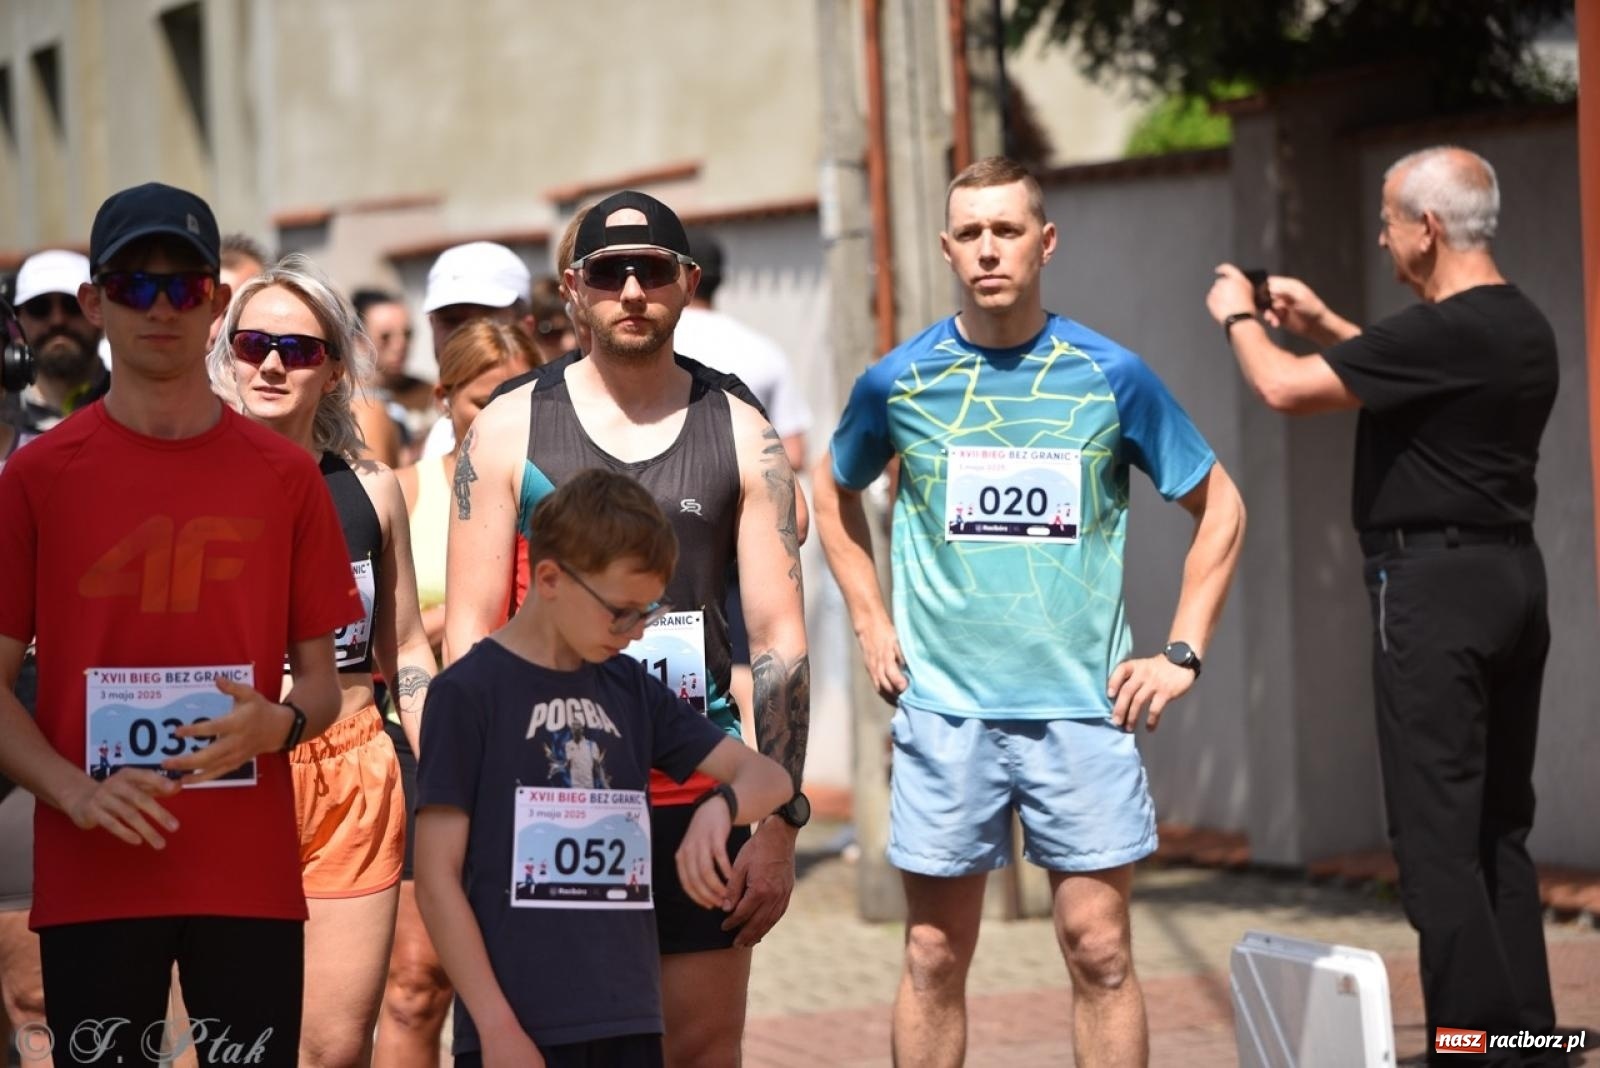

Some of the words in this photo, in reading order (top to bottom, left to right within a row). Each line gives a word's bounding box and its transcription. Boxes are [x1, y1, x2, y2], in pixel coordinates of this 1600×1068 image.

[981, 451, 1005, 459] BIEG
[1009, 451, 1028, 460] BEZ
[1031, 452, 1071, 461] GRANIC
[979, 486, 1048, 517] 020
[78, 514, 266, 613] 4F
[101, 672, 126, 684] XVII
[130, 671, 161, 684] BIEG
[165, 671, 190, 683] BEZ
[194, 669, 242, 682] GRANIC
[100, 691, 106, 699] 3
[108, 691, 134, 702] maja
[137, 691, 162, 700] 2025
[525, 698, 622, 740] POGBA
[129, 717, 218, 757] 039
[529, 791, 554, 802] XVII
[558, 792, 586, 804] BIEG
[590, 792, 610, 804] BEZ
[537, 809, 561, 820] maja
[564, 810, 586, 819] 2025
[554, 838, 626, 876] 052
